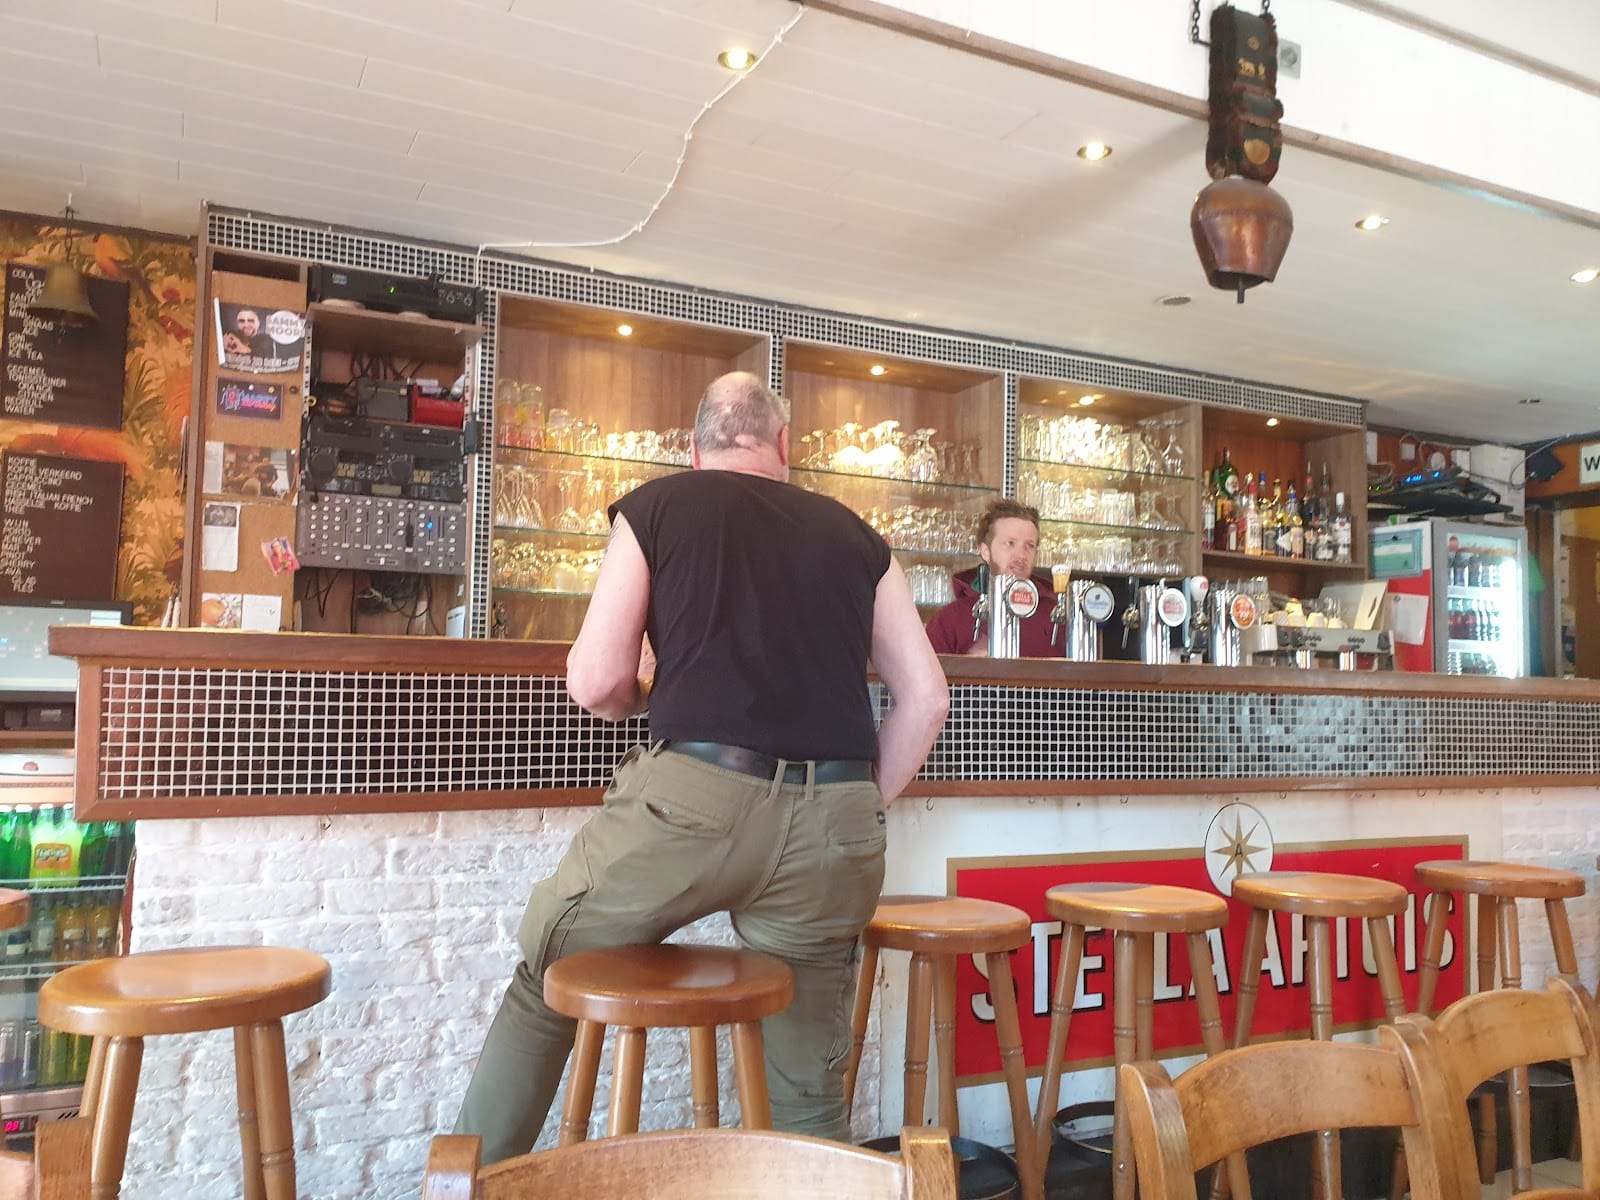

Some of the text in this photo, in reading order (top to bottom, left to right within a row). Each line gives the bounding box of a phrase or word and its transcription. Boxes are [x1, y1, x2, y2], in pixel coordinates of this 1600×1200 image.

[12, 268, 35, 280] COLA
[10, 292, 37, 304] FANTA
[27, 350, 43, 361] TEA
[7, 363, 46, 376] CECEMEL
[5, 404, 35, 415] WATER
[8, 456, 37, 467] KOFFIE
[8, 464, 82, 480] KOFFIE VERKEERD
[30, 490, 60, 502] ITALIAN
[62, 493, 93, 505] FRENCH
[4, 504, 25, 515] THEE
[54, 502, 81, 513] KOFFIE
[3, 518, 29, 529] WIJN
[1235, 844, 1244, 856] A
[971, 920, 1231, 1021] STELA
